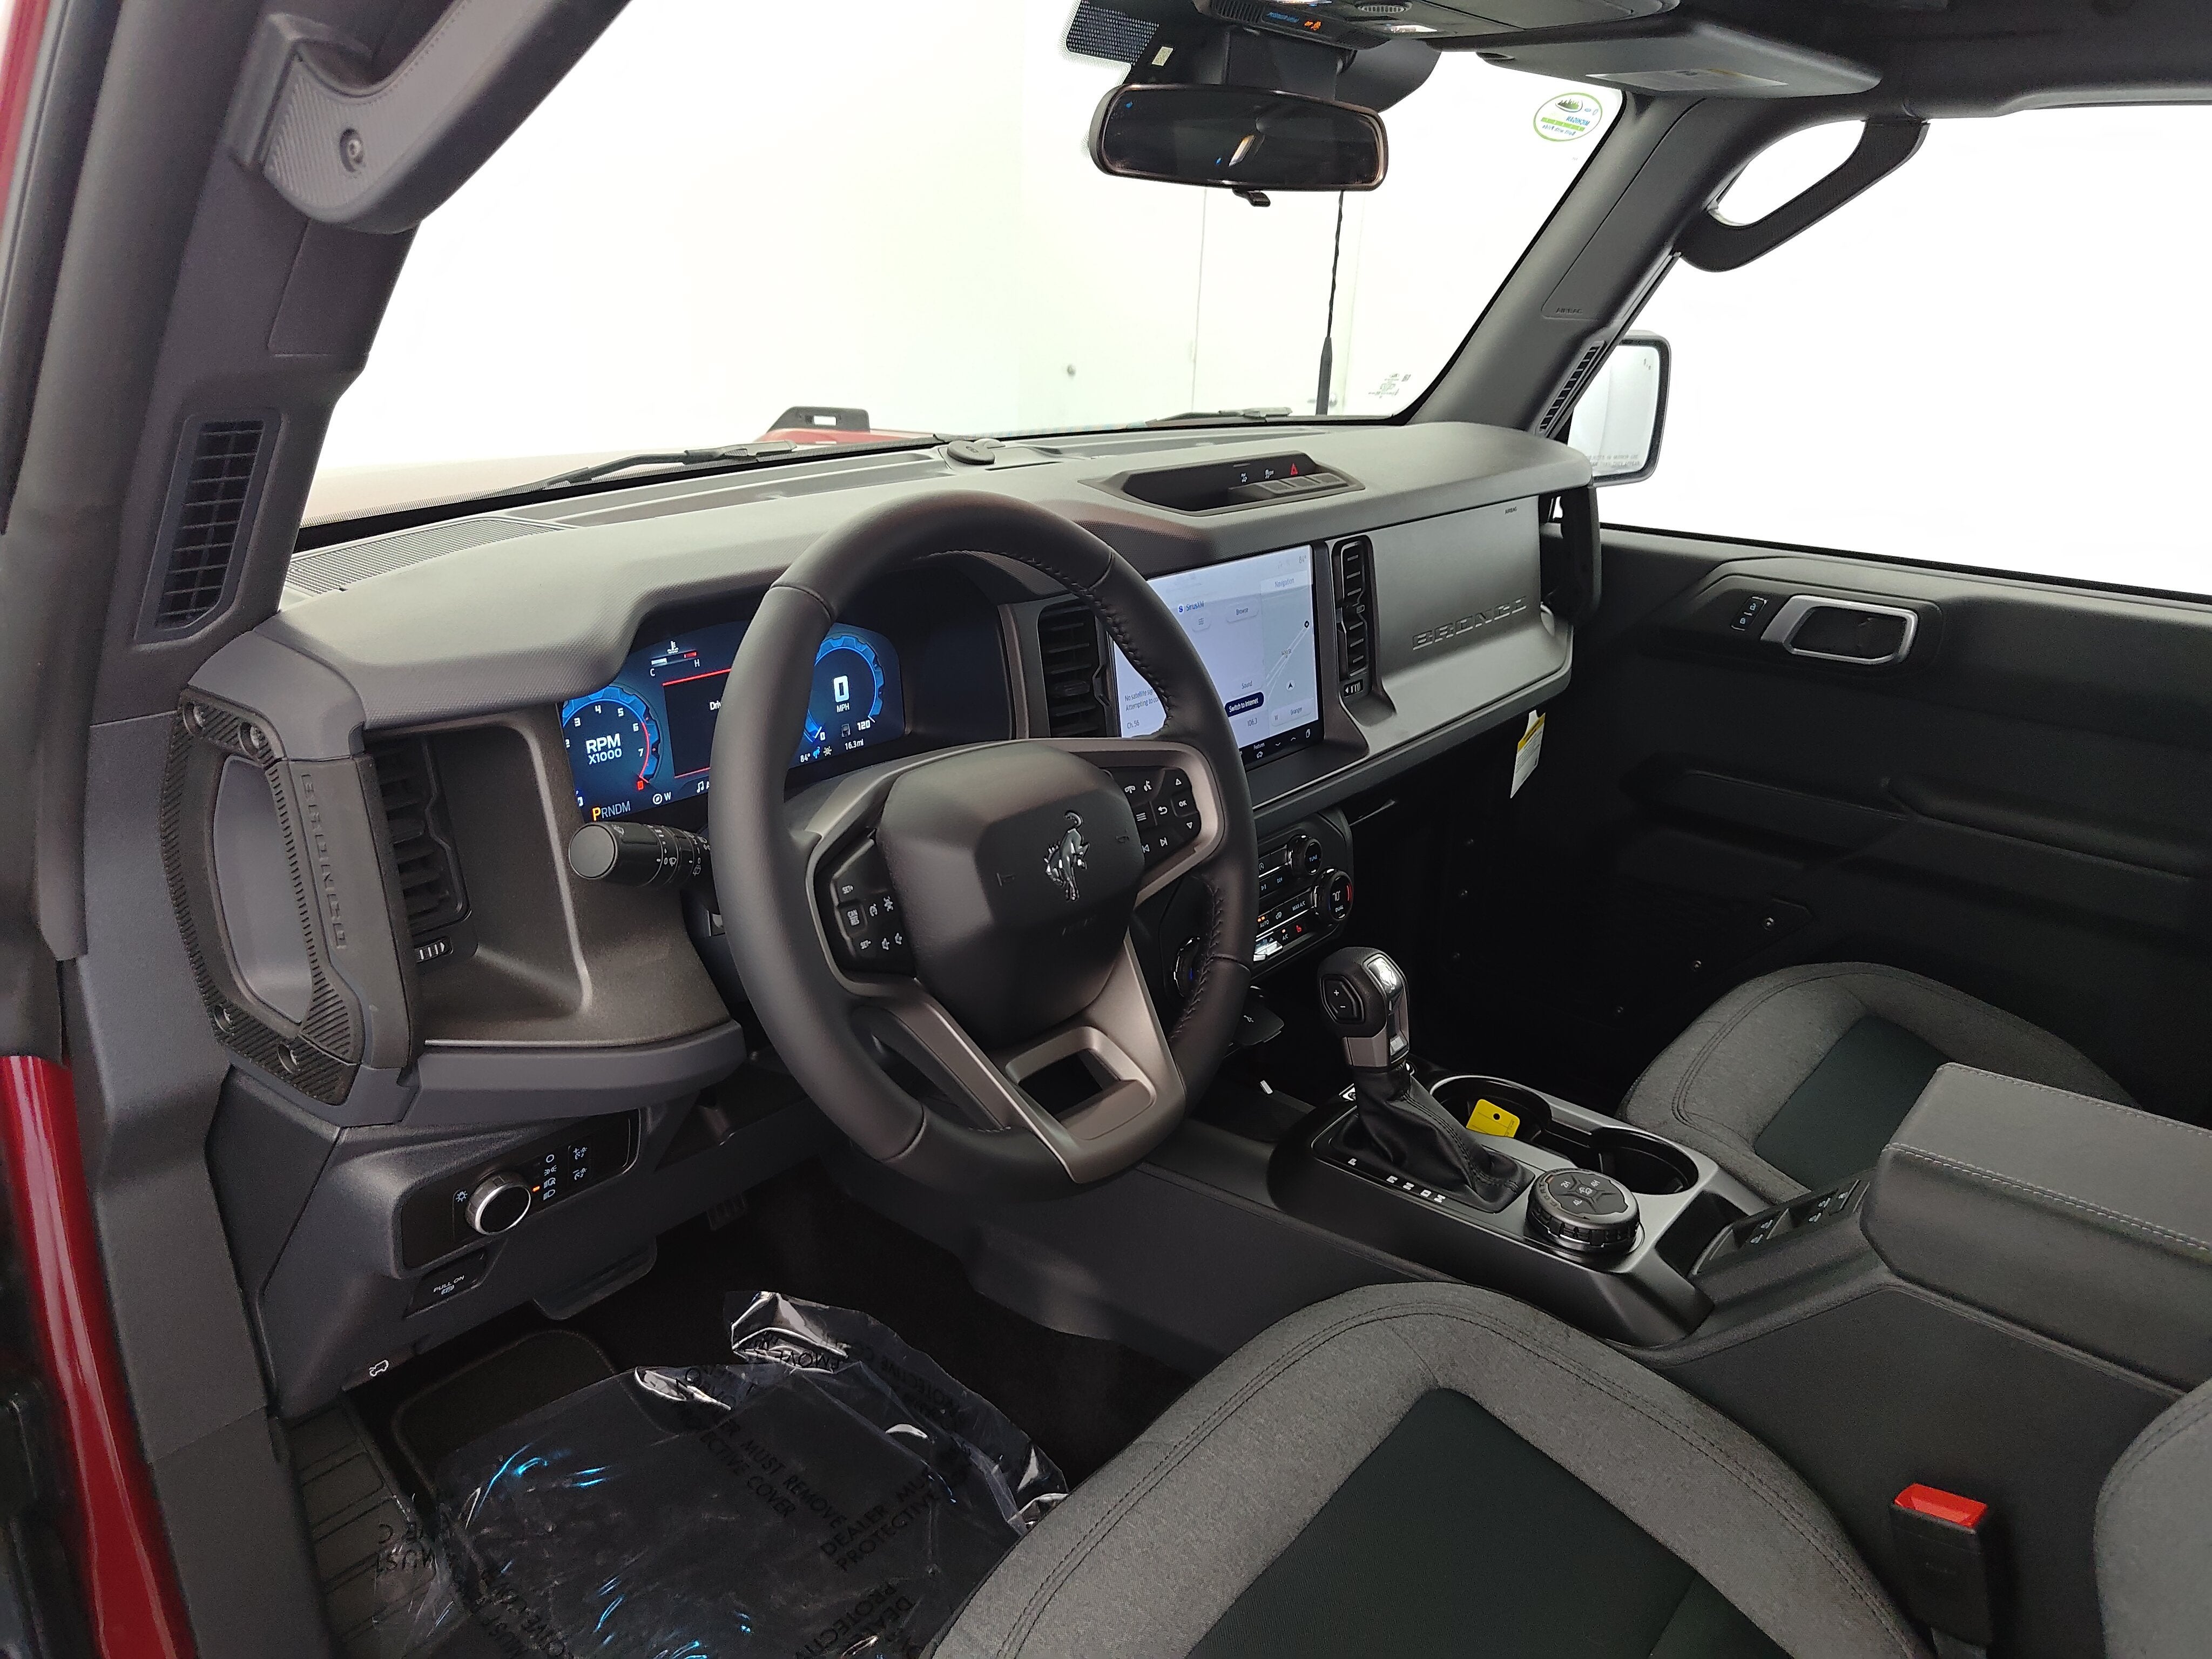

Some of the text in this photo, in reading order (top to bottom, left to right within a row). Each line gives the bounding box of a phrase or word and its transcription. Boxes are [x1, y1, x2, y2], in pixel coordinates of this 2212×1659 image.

[1412, 596, 1527, 651] BRONCO
[694, 659, 700, 667] H
[650, 669, 656, 677] C
[833, 675, 849, 703] 0
[1242, 680, 1253, 690] Sound
[1131, 689, 1147, 699] satellite
[595, 705, 602, 714] 4
[837, 703, 850, 713] MPH
[1125, 699, 1148, 711] Attempting
[1229, 703, 1241, 713] Switch
[1245, 697, 1259, 707] Internet
[617, 707, 624, 717] 5
[574, 717, 581, 727] 3
[857, 719, 871, 731] 120
[632, 723, 639, 732] 6
[586, 733, 621, 754] RPM
[1253, 742, 1265, 751] Features
[588, 748, 622, 765] X1000
[638, 748, 644, 757] 7
[664, 791, 671, 801] W
[1259, 919, 1270, 928] AUTO
[434, 1275, 464, 1293] PULL ON
[746, 1474, 797, 1518] COVER
[783, 1474, 847, 1529] REMOVE
[819, 1503, 888, 1557] DEALER
